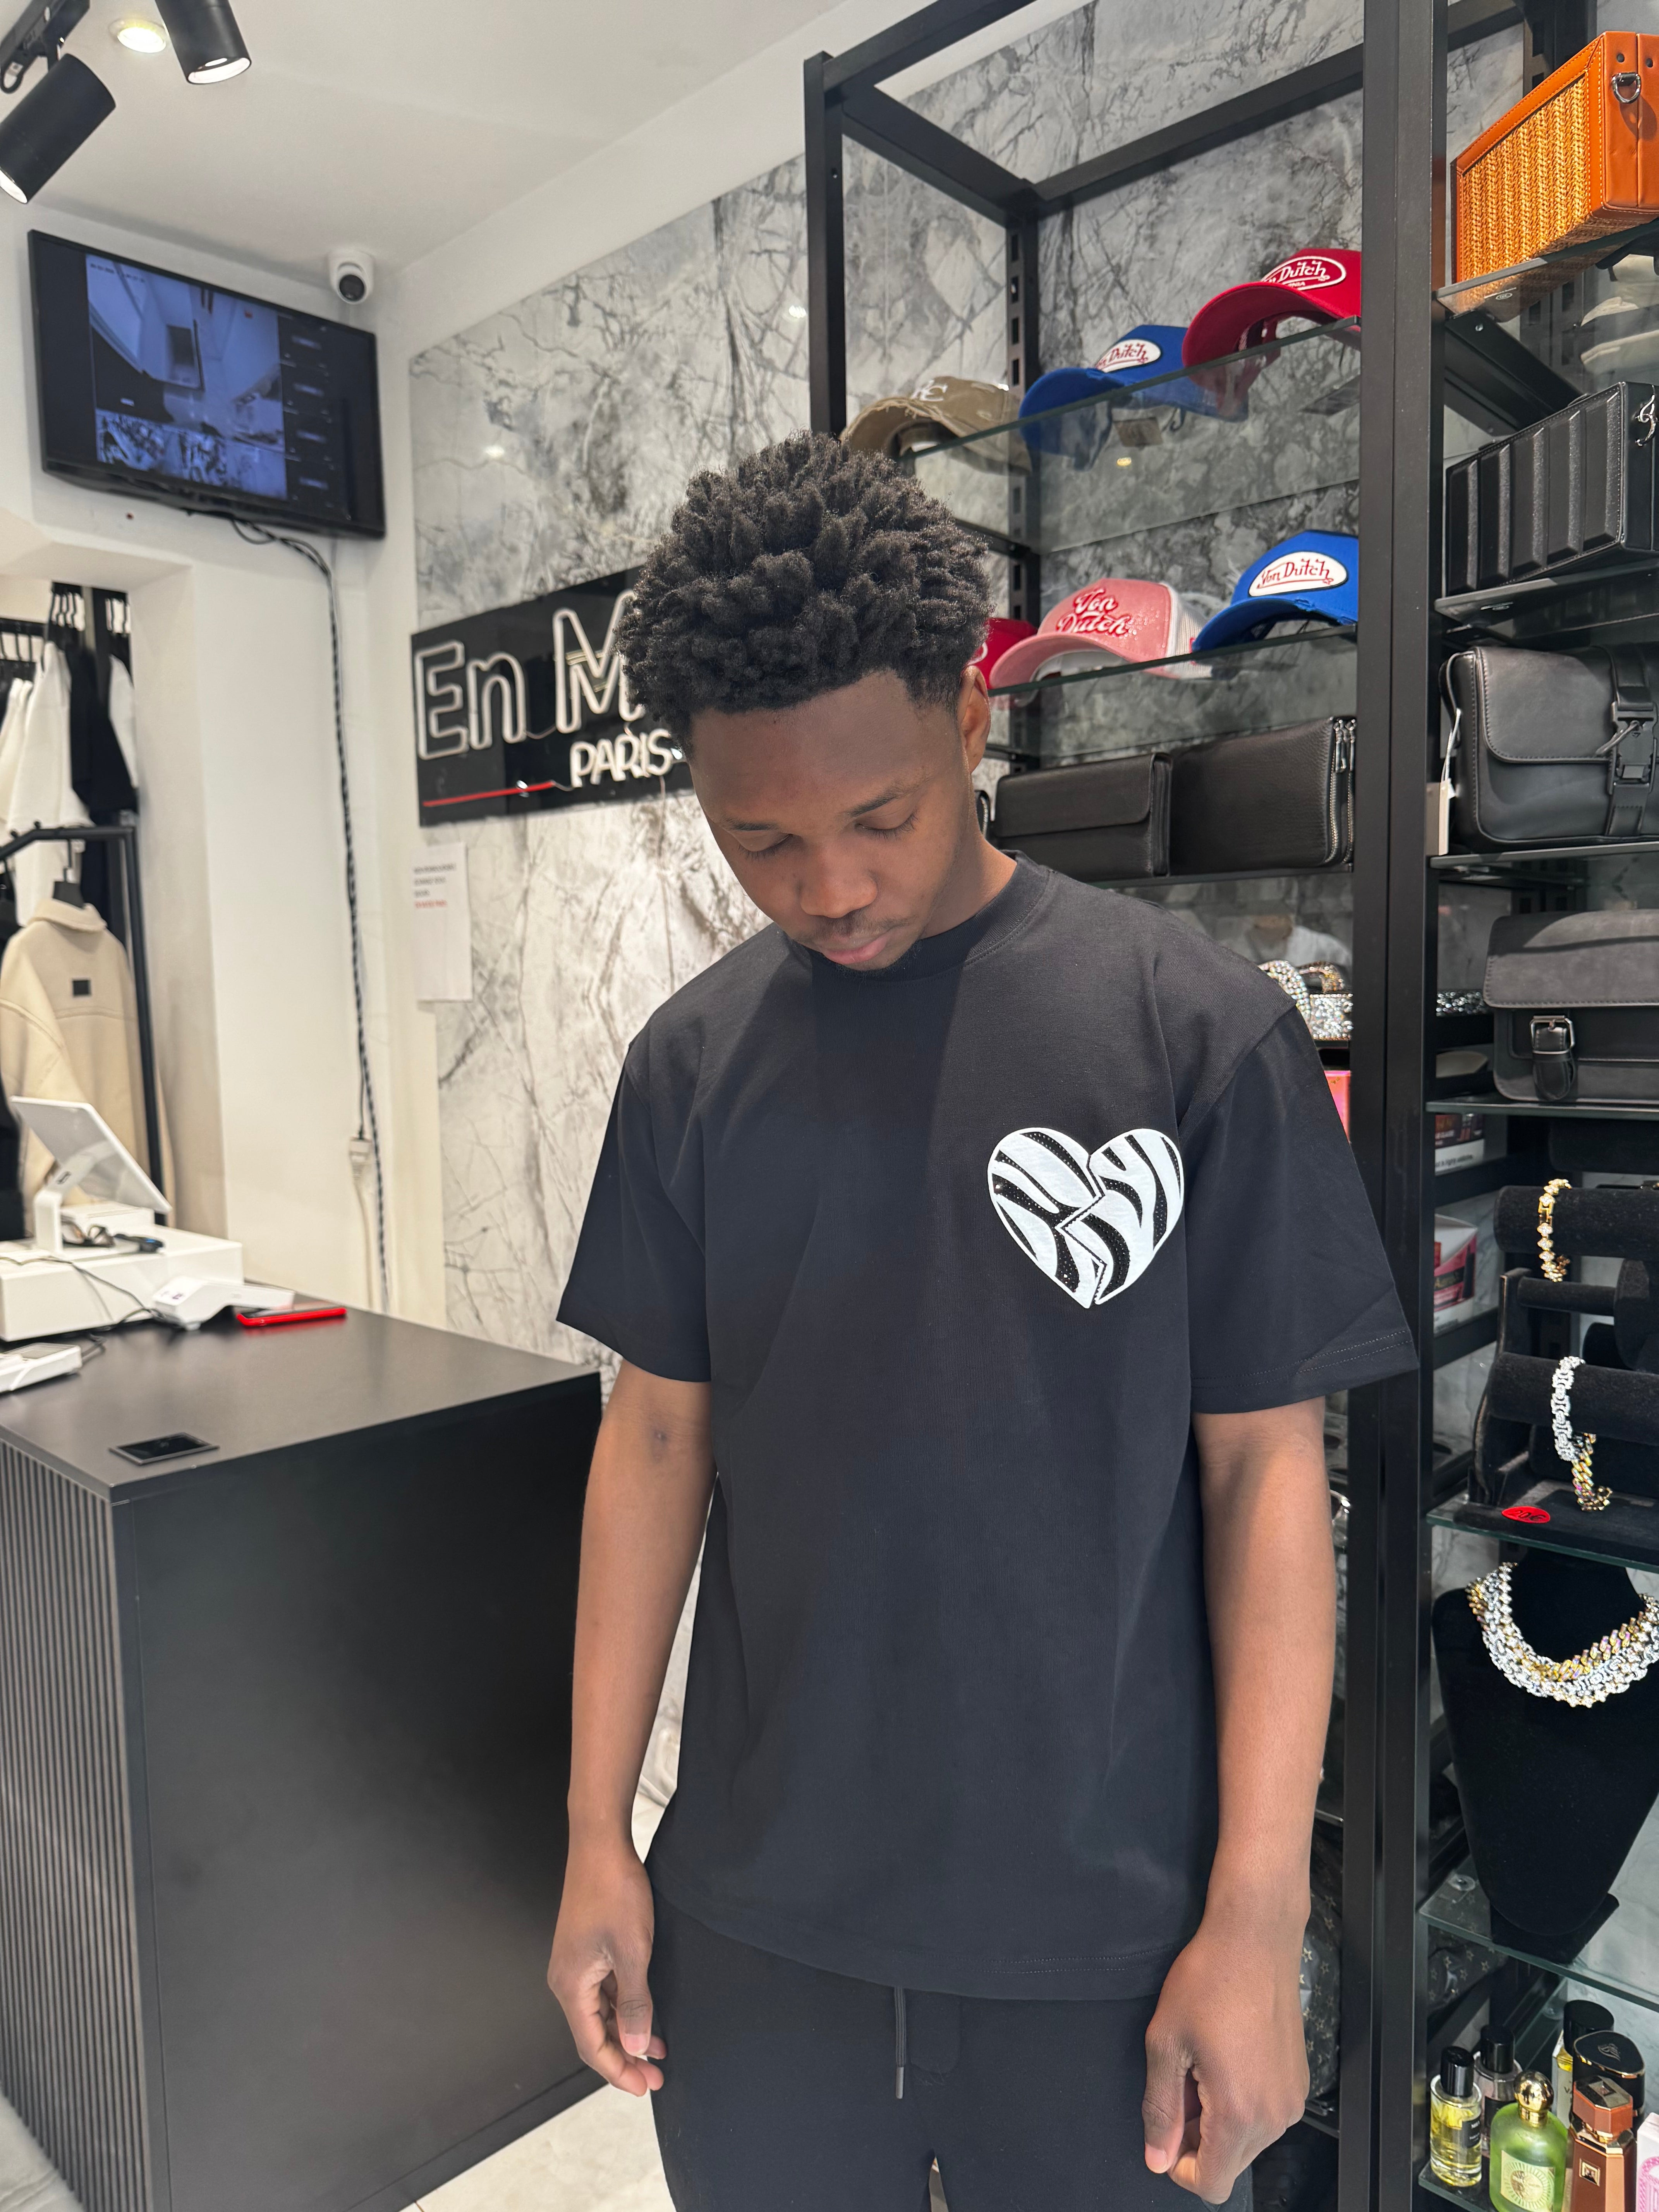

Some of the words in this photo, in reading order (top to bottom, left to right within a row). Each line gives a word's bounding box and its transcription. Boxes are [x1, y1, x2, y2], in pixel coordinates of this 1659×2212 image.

[1278, 260, 1327, 283] Dutch
[1108, 342, 1146, 363] Dutch
[1261, 570, 1280, 586] Von
[1281, 558, 1330, 580] Dutch
[1074, 588, 1118, 614] Von
[1056, 610, 1131, 637] Dutch
[415, 639, 527, 761] En
[570, 729, 673, 788] PARIS
